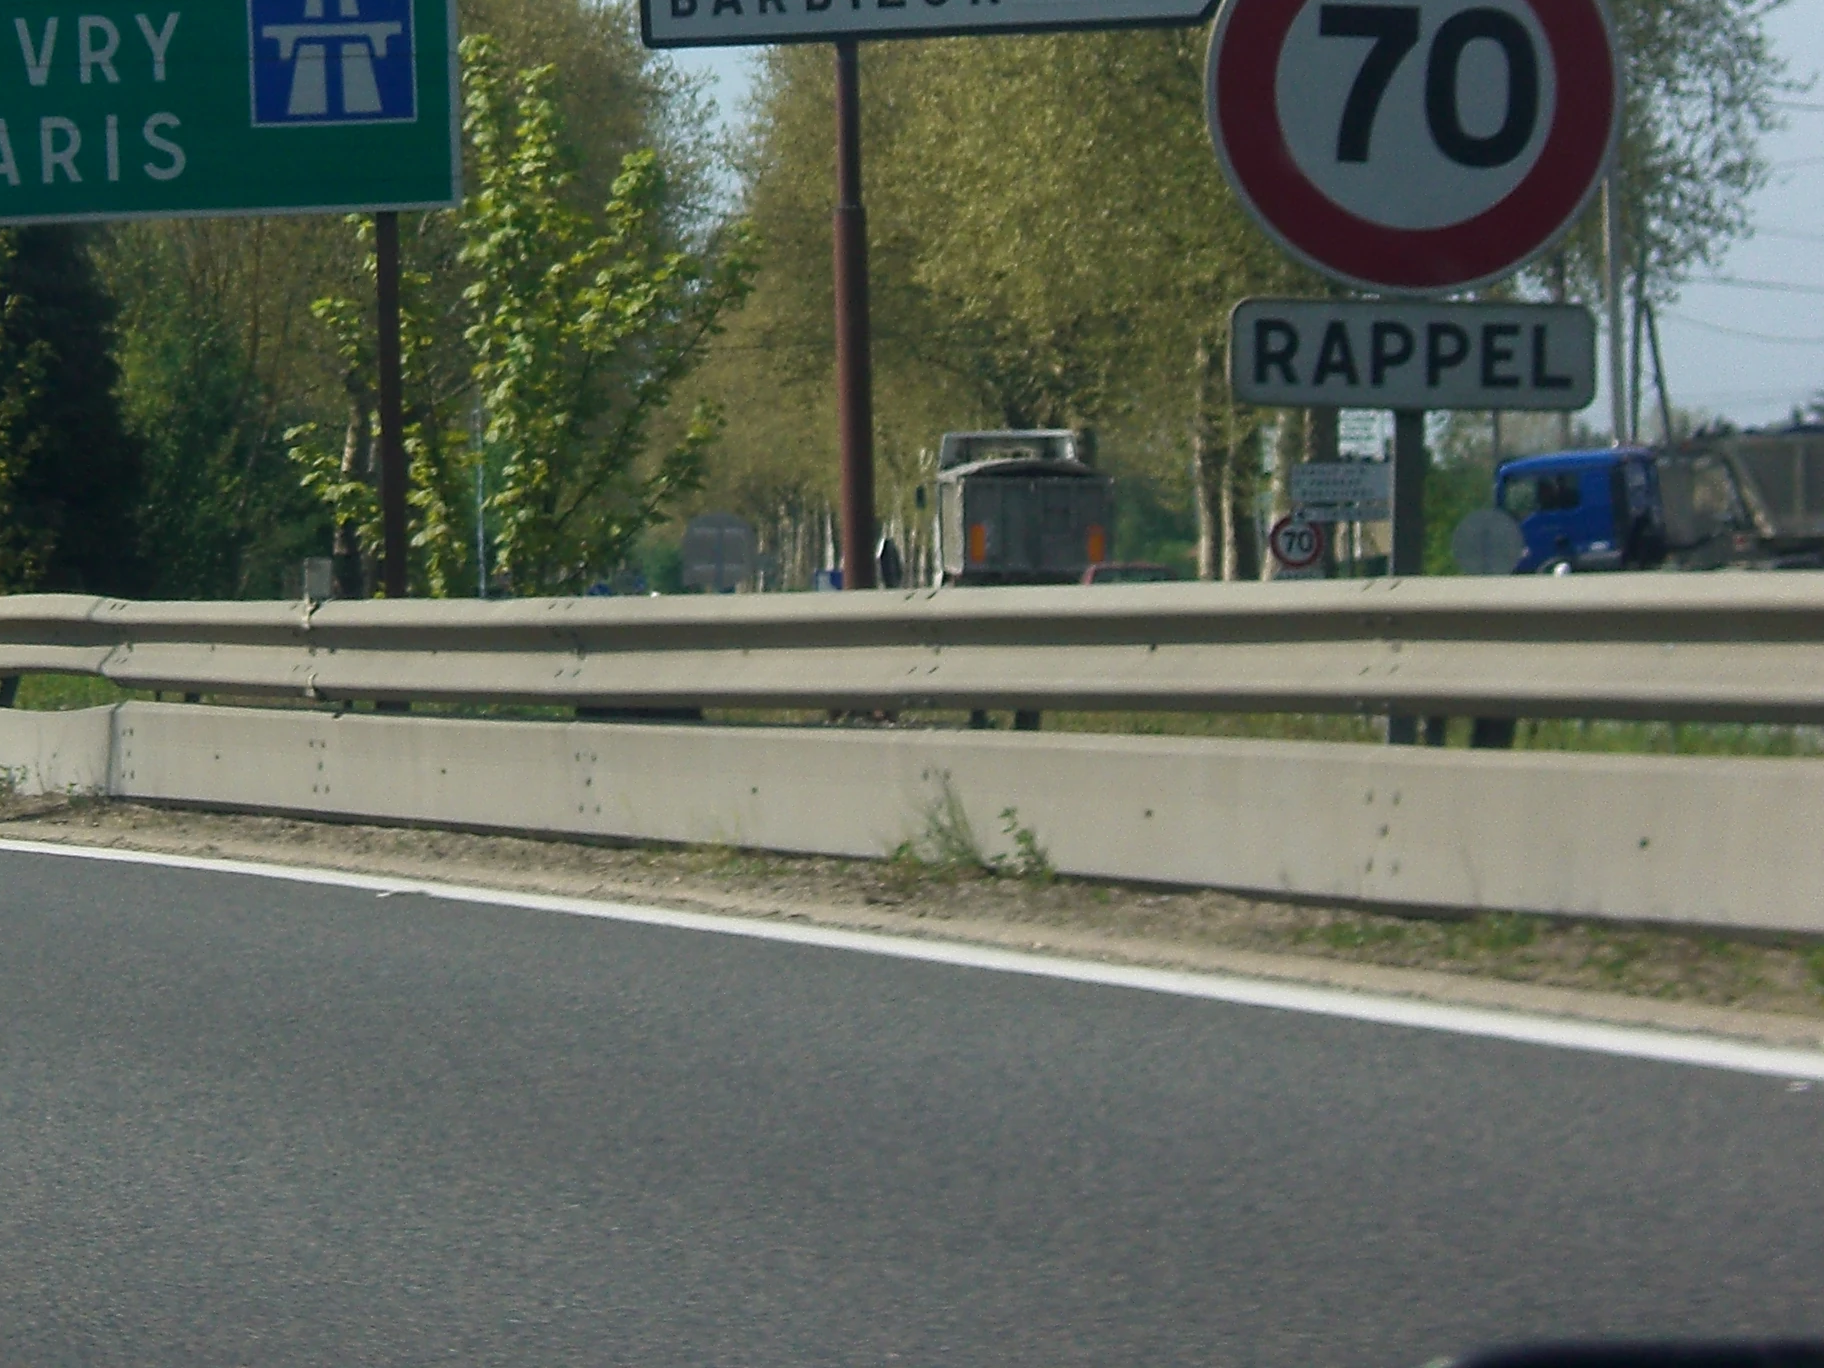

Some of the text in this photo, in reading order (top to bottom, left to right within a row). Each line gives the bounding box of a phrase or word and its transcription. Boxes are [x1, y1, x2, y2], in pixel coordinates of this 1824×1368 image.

[1318, 3, 1539, 169] 70
[1252, 317, 1573, 391] RAPPEL
[1283, 530, 1312, 553] 70
